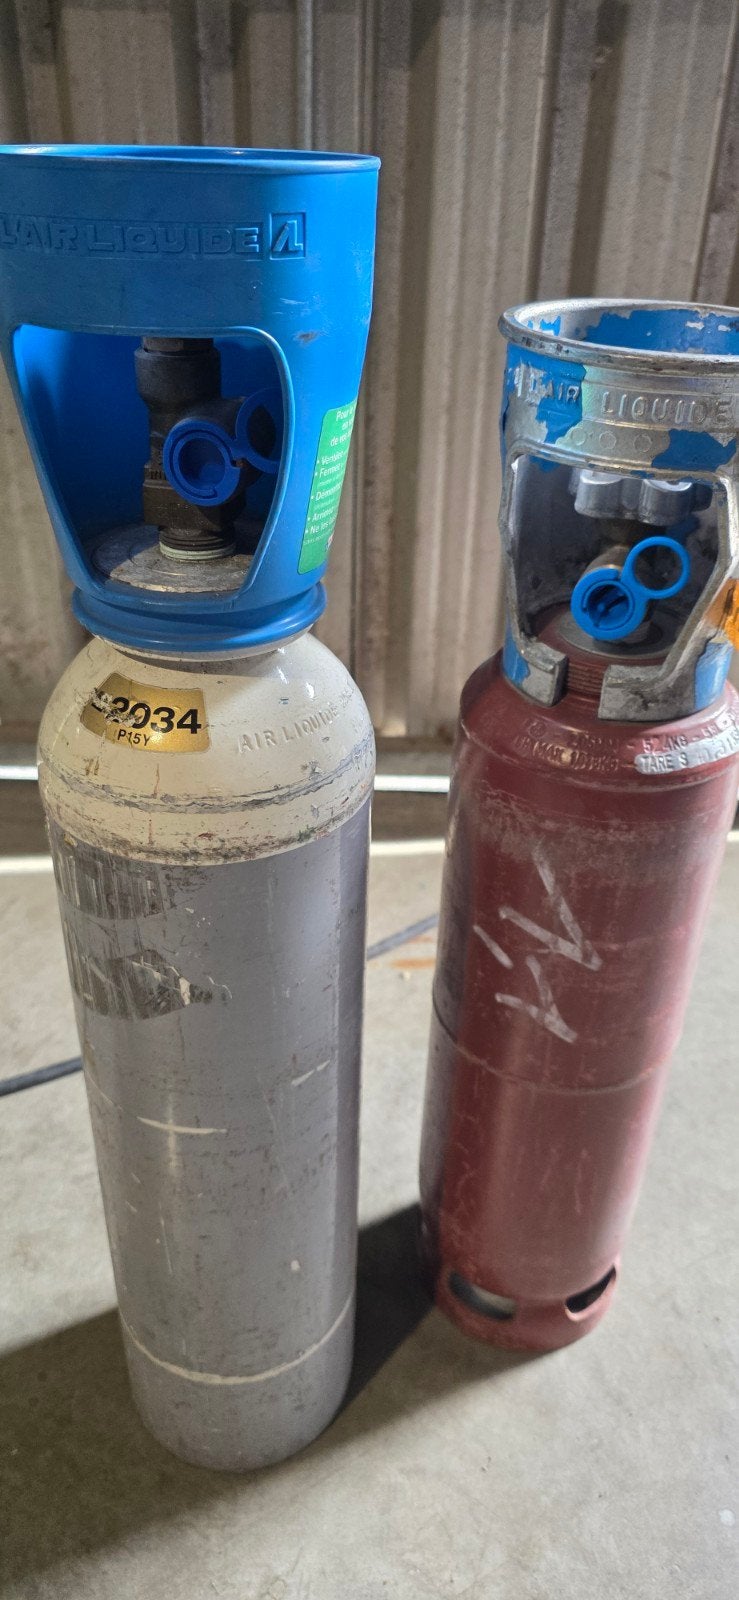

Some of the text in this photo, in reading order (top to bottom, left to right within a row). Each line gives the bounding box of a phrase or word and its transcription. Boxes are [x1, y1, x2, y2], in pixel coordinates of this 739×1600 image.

[86, 221, 260, 254] LIQUIDE
[602, 391, 732, 427] LIQUIDE
[117, 728, 151, 747] P15Y
[237, 729, 278, 753] AIR
[640, 753, 673, 773] TARE
